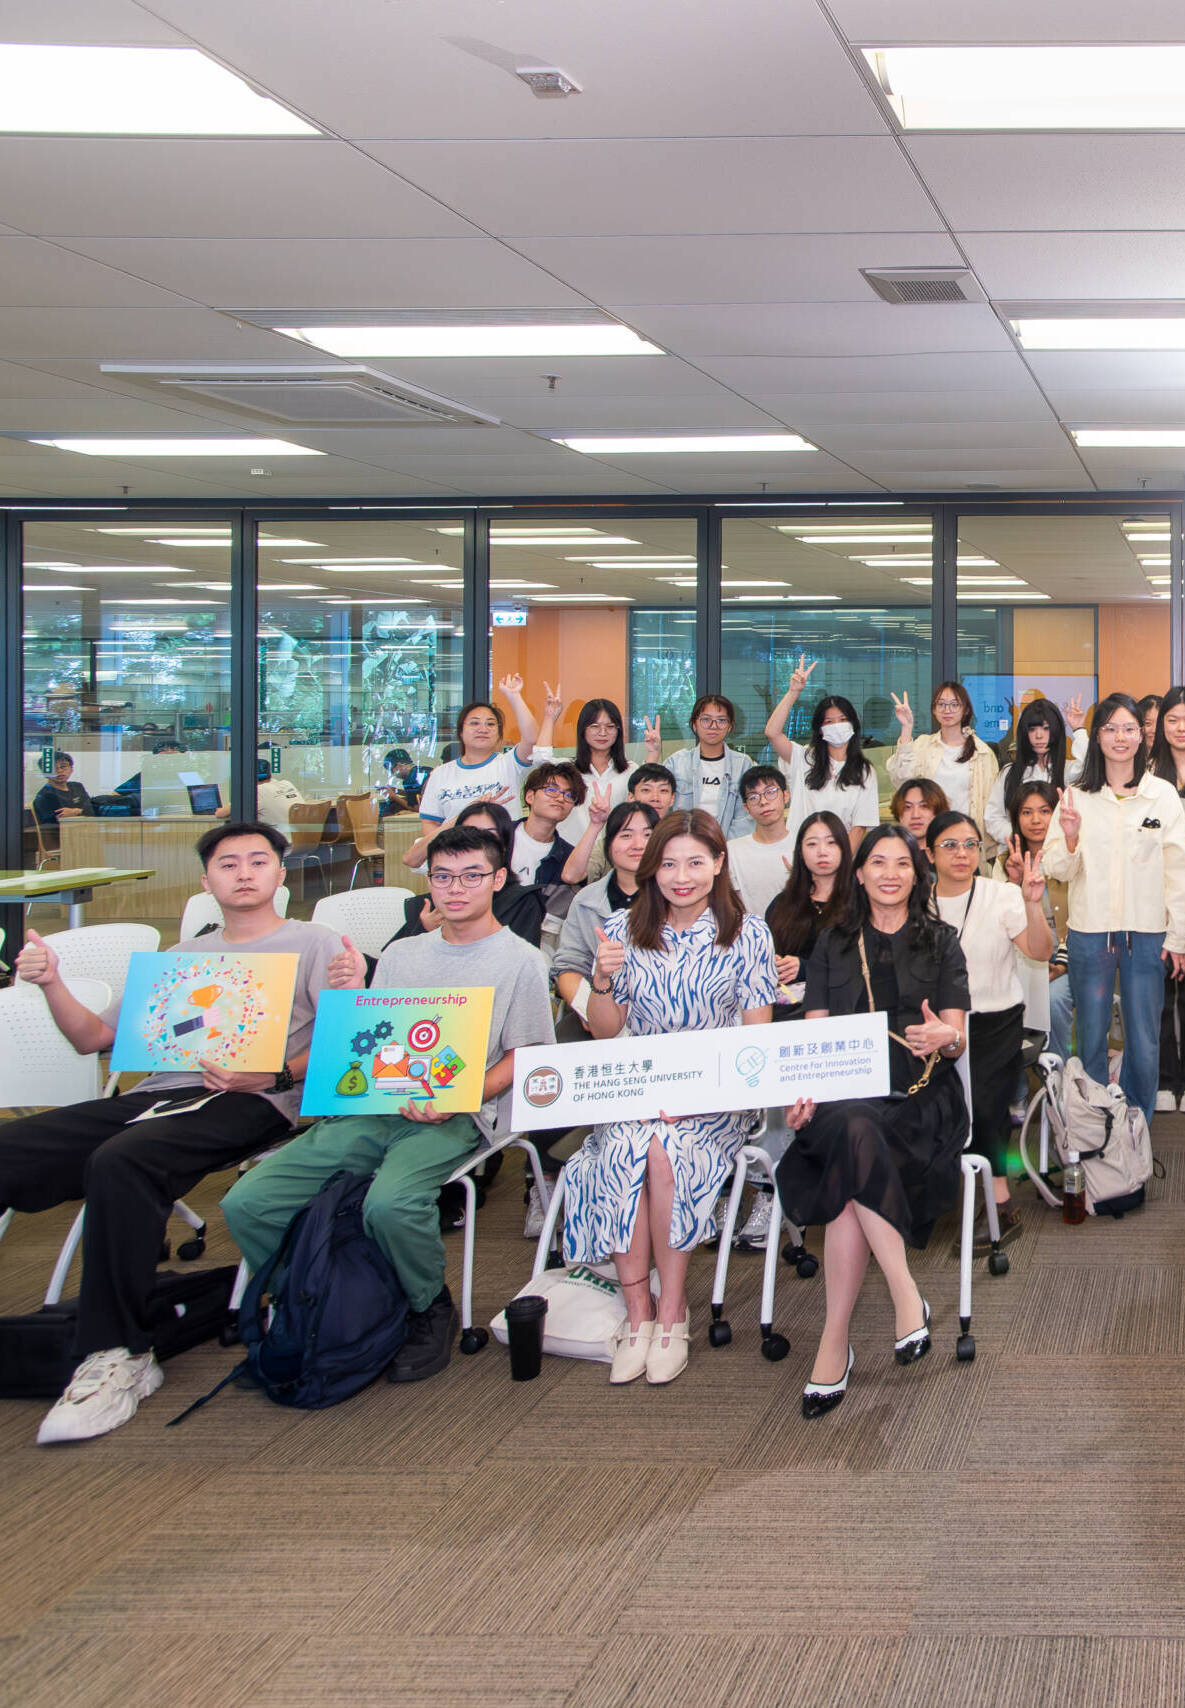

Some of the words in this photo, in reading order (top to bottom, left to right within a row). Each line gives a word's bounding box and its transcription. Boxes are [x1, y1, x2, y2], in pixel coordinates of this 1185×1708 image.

[702, 777, 721, 785] ILA
[355, 993, 468, 1007] Entrepreneurship
[779, 1038, 874, 1058] 創新及創業中心
[574, 1059, 653, 1080] 香港恒生大學
[780, 1062, 809, 1073] Centre
[810, 1061, 823, 1071] for
[825, 1056, 871, 1069] Innovation
[573, 1081, 591, 1090] THE
[593, 1078, 621, 1089] HANG
[623, 1075, 647, 1086] SENG
[650, 1070, 704, 1083] UNIVERSITY
[780, 1072, 796, 1082] and
[798, 1066, 873, 1081] Entrepreneurship
[573, 1092, 586, 1102] OF
[587, 1090, 615, 1101] HONG
[617, 1087, 644, 1098] KONG
